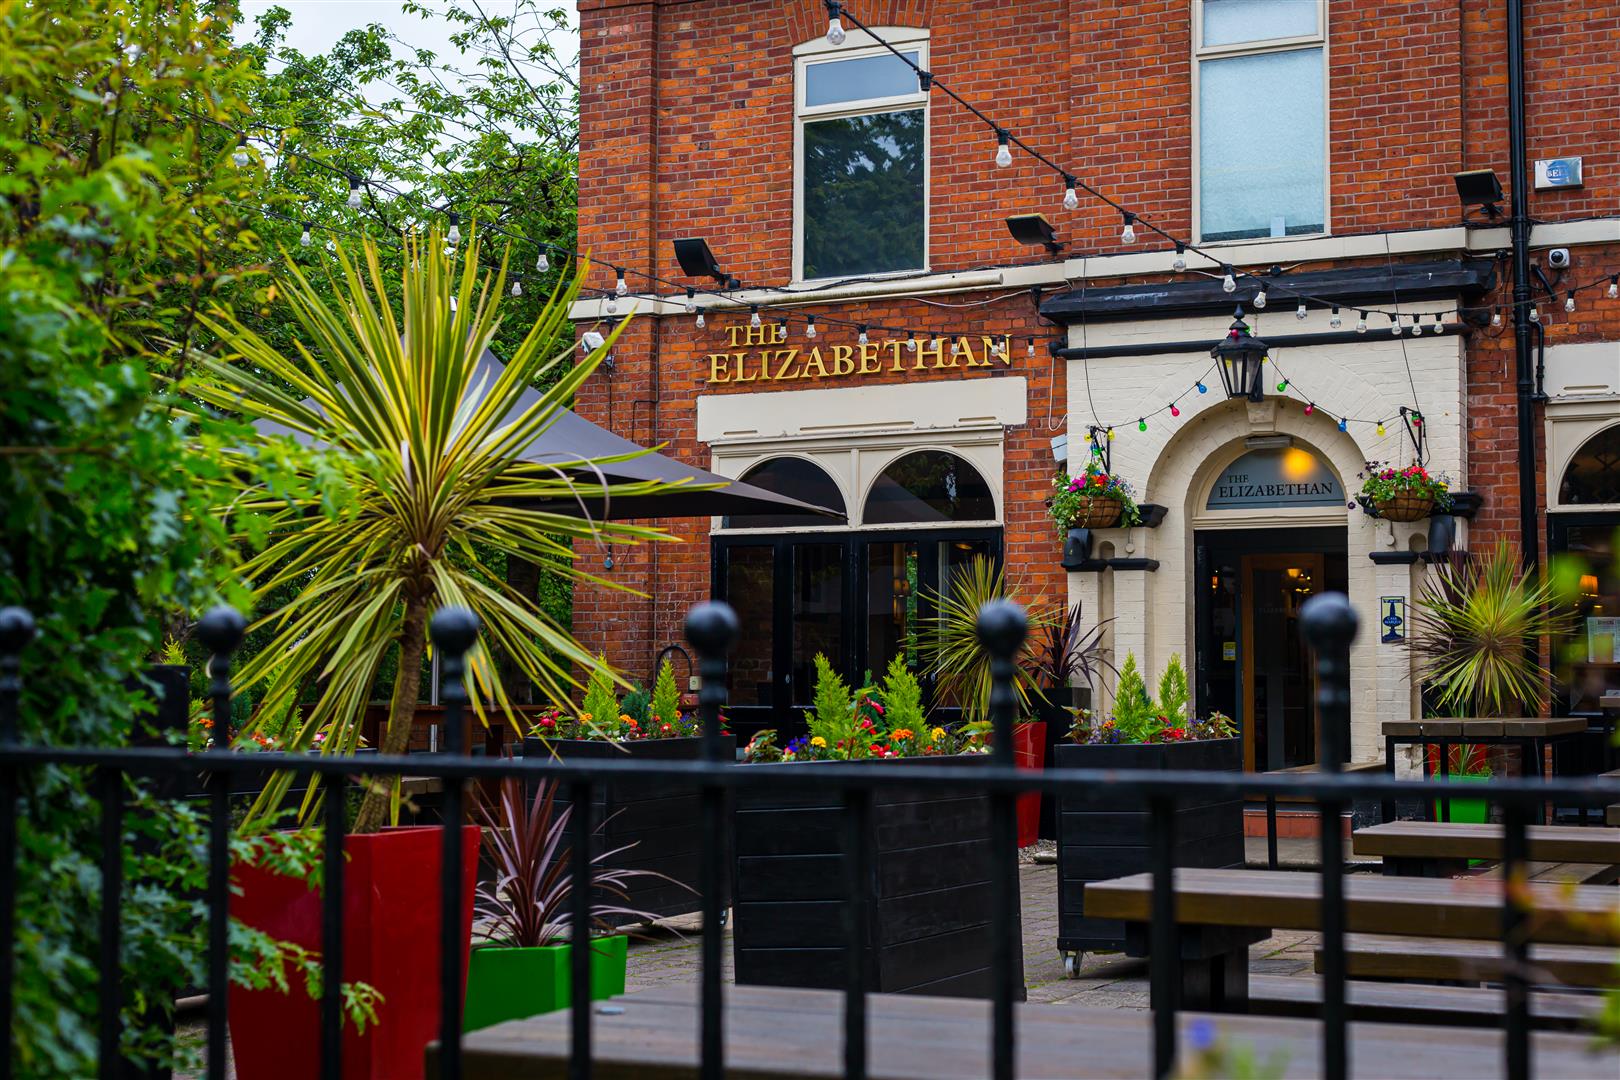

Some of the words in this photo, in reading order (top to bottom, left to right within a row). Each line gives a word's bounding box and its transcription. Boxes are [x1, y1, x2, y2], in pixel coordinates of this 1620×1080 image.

[725, 323, 786, 346] THE
[706, 334, 1013, 383] ELIZABETHAN
[1227, 474, 1249, 484] THE
[1219, 482, 1333, 498] ELIZABETHAN
